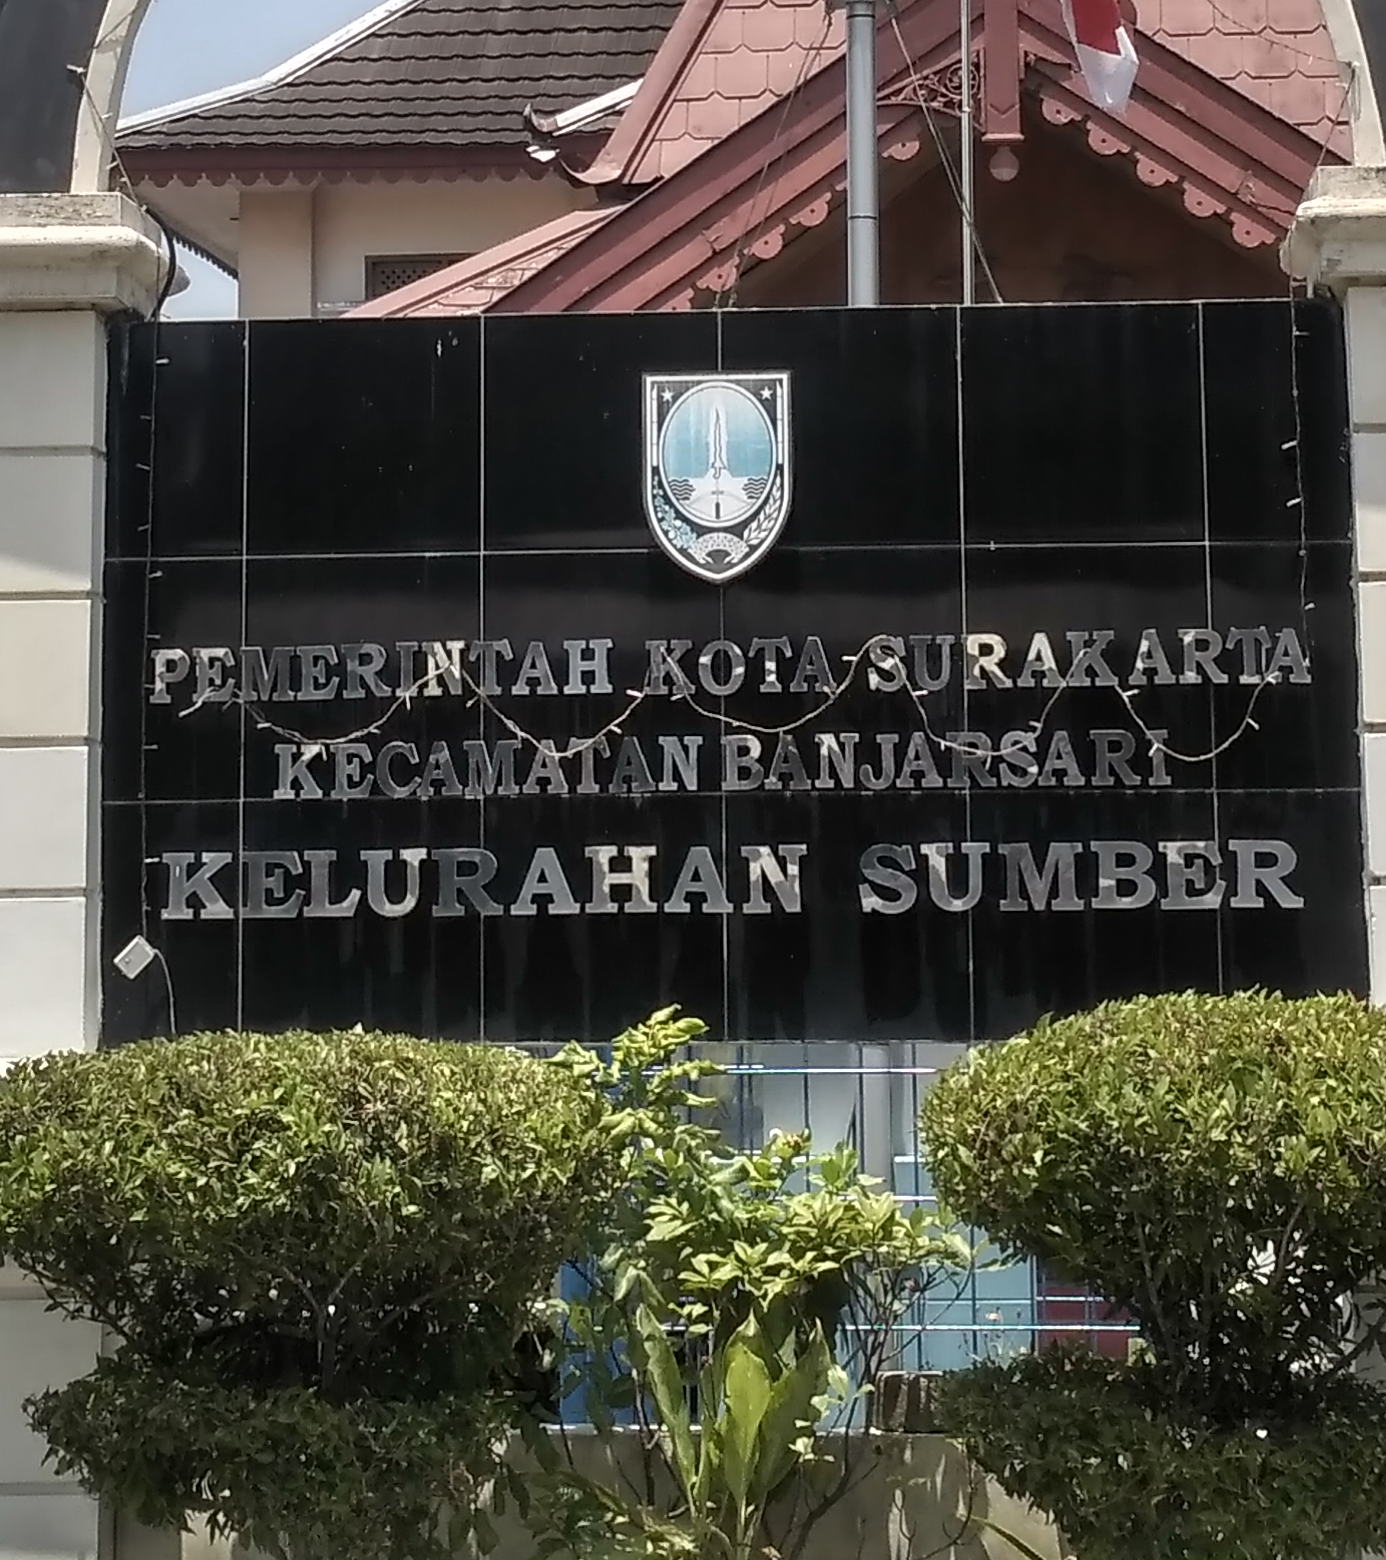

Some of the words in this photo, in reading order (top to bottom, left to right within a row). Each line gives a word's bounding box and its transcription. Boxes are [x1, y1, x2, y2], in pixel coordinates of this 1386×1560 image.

[149, 639, 614, 704] PEMERINTAH
[645, 636, 837, 695] KOTA
[866, 627, 1312, 692] SURAKARTA
[273, 735, 704, 799] KECAMATAN
[720, 730, 1172, 791] BANJARSARI
[161, 844, 808, 919] KELURAHAN
[858, 839, 1305, 915] SUMBER
